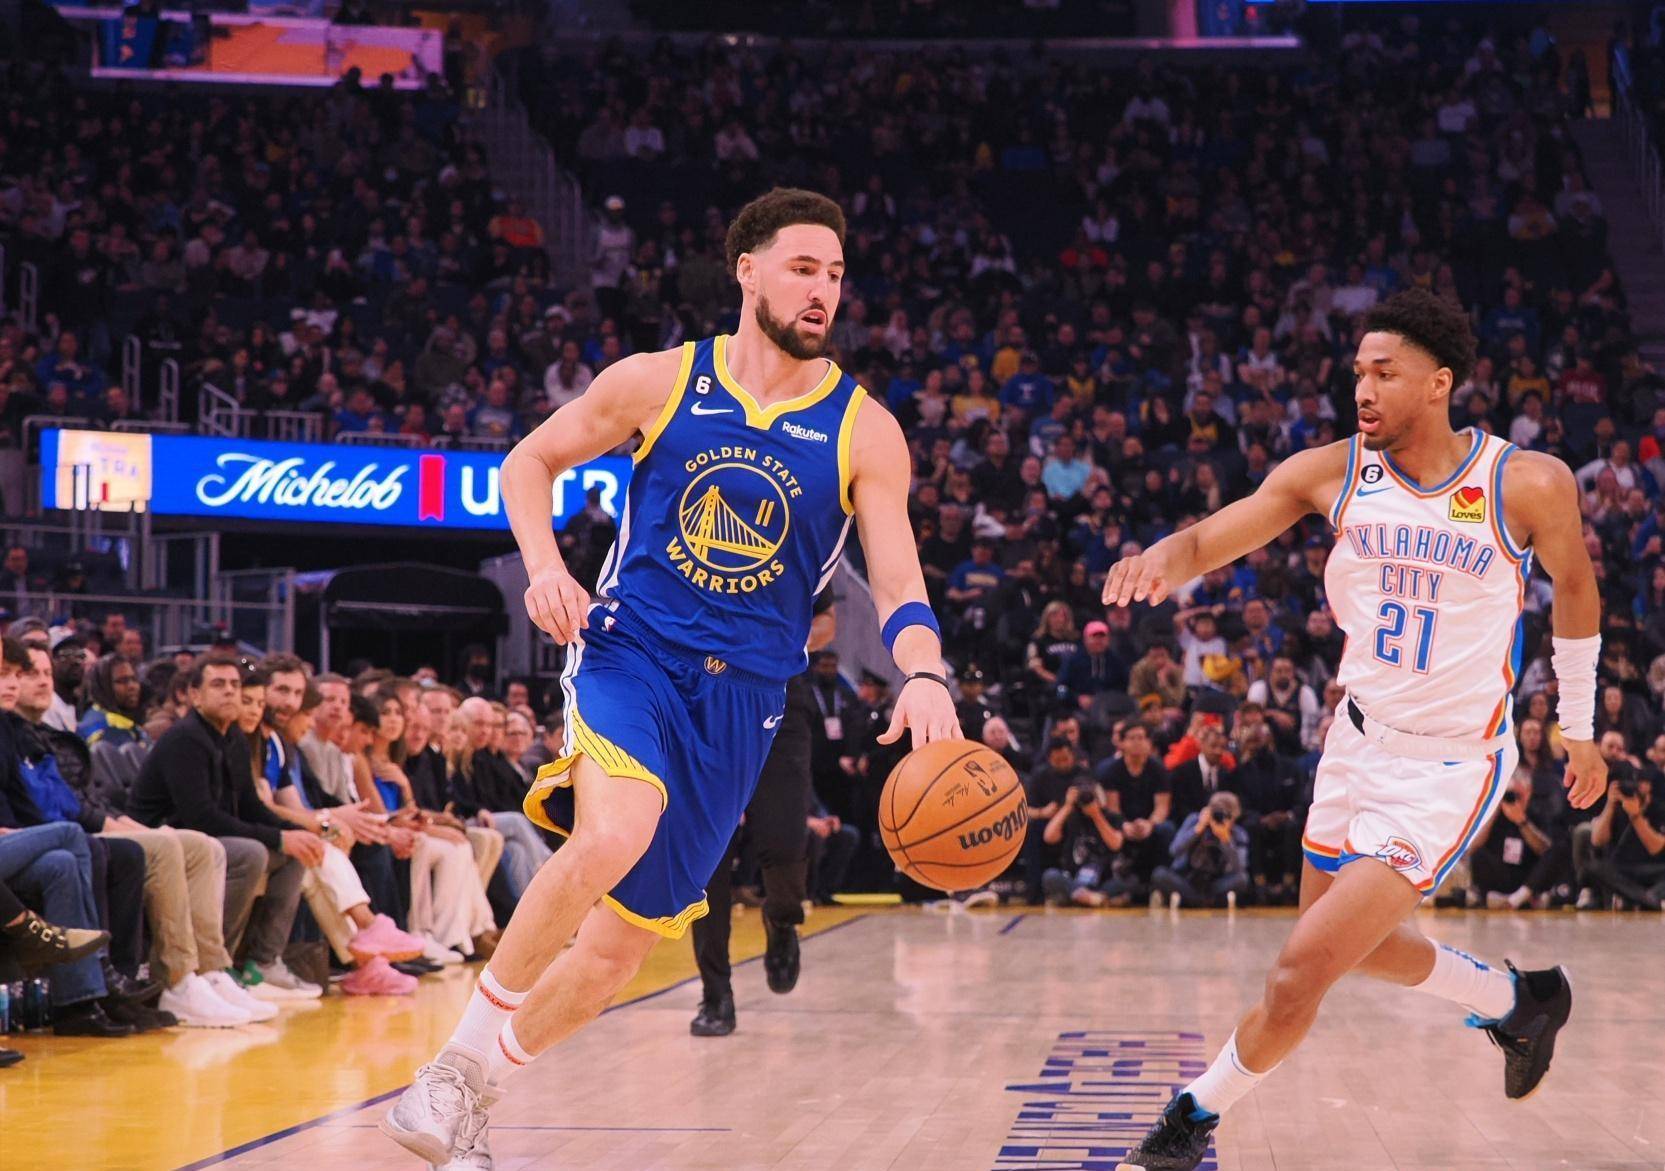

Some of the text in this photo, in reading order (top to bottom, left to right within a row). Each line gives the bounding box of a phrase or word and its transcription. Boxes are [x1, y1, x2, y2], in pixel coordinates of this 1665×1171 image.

[695, 376, 711, 394] 6
[782, 421, 828, 443] Rakuten
[196, 453, 618, 518] Michelob UTR
[685, 447, 803, 498] GOLDEN STATE
[1364, 465, 1380, 483] 6
[755, 499, 774, 527] 11
[666, 536, 785, 594] WARRIORS
[1380, 563, 1443, 601] CITY
[1373, 599, 1438, 675] 21
